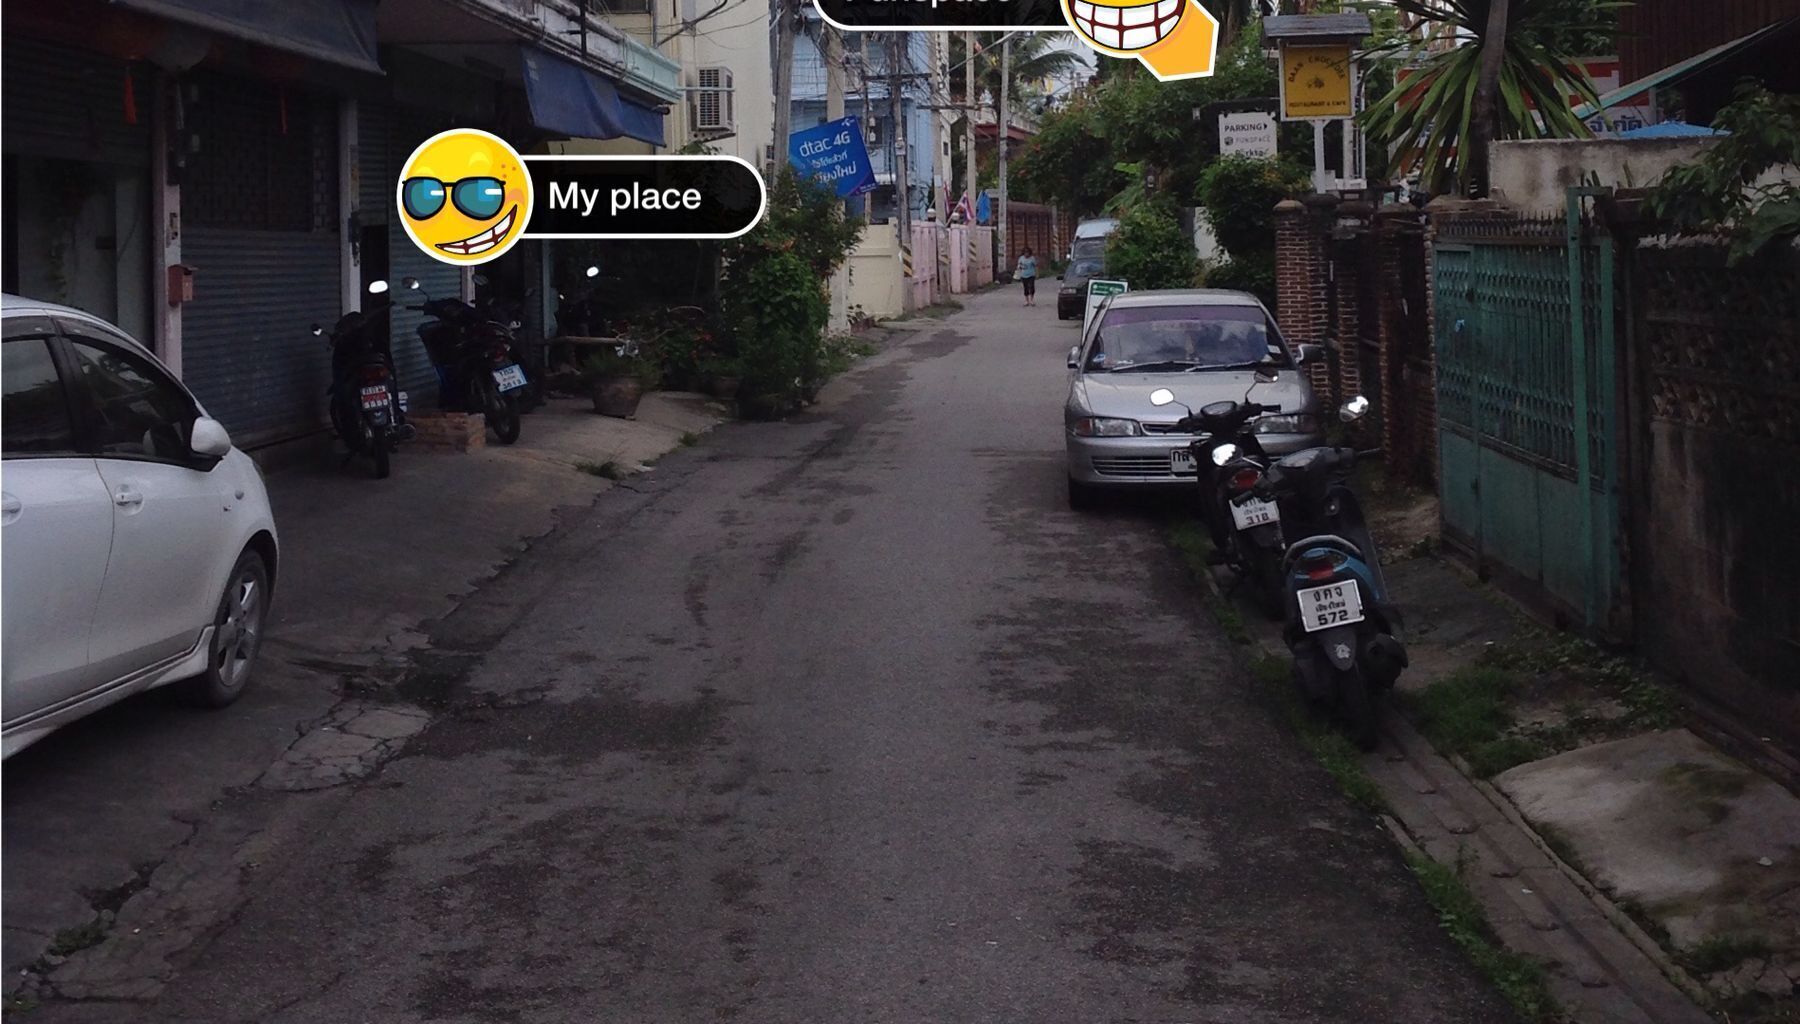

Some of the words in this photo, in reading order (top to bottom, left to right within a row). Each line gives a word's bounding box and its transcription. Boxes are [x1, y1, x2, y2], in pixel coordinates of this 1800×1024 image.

[1225, 123, 1262, 132] PARKING
[800, 138, 833, 157] dtac
[834, 131, 851, 146] 4G
[1318, 609, 1348, 625] 572
